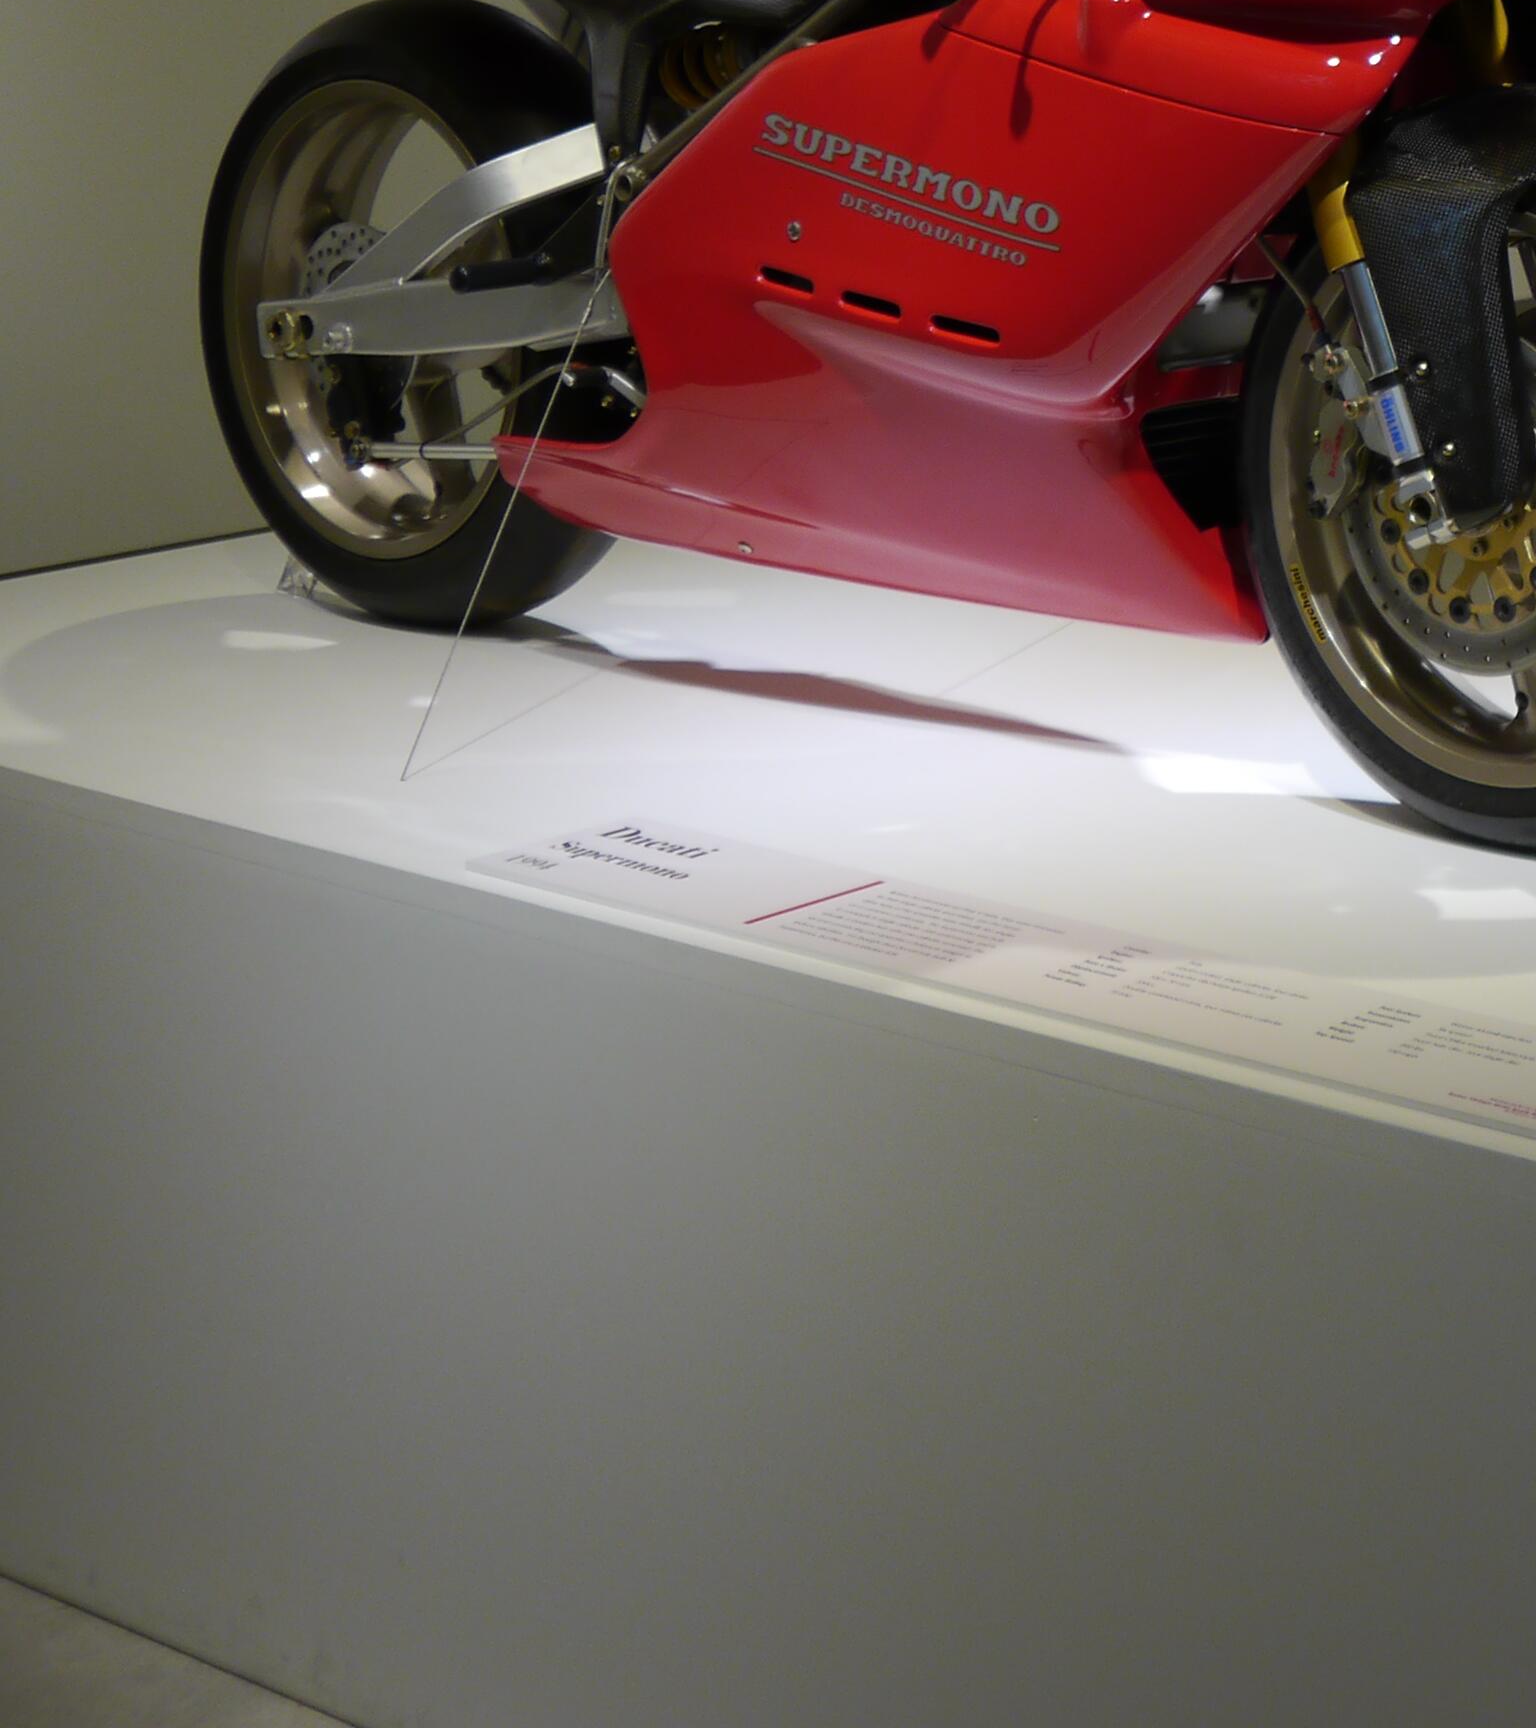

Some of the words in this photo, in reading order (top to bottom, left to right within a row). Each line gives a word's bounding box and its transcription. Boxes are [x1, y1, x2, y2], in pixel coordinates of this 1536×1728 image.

[761, 112, 1061, 234] SUPERMONO
[840, 191, 1028, 266] DESMOQUATTRO
[555, 841, 689, 880] Supermono
[601, 826, 719, 859] Ducati
